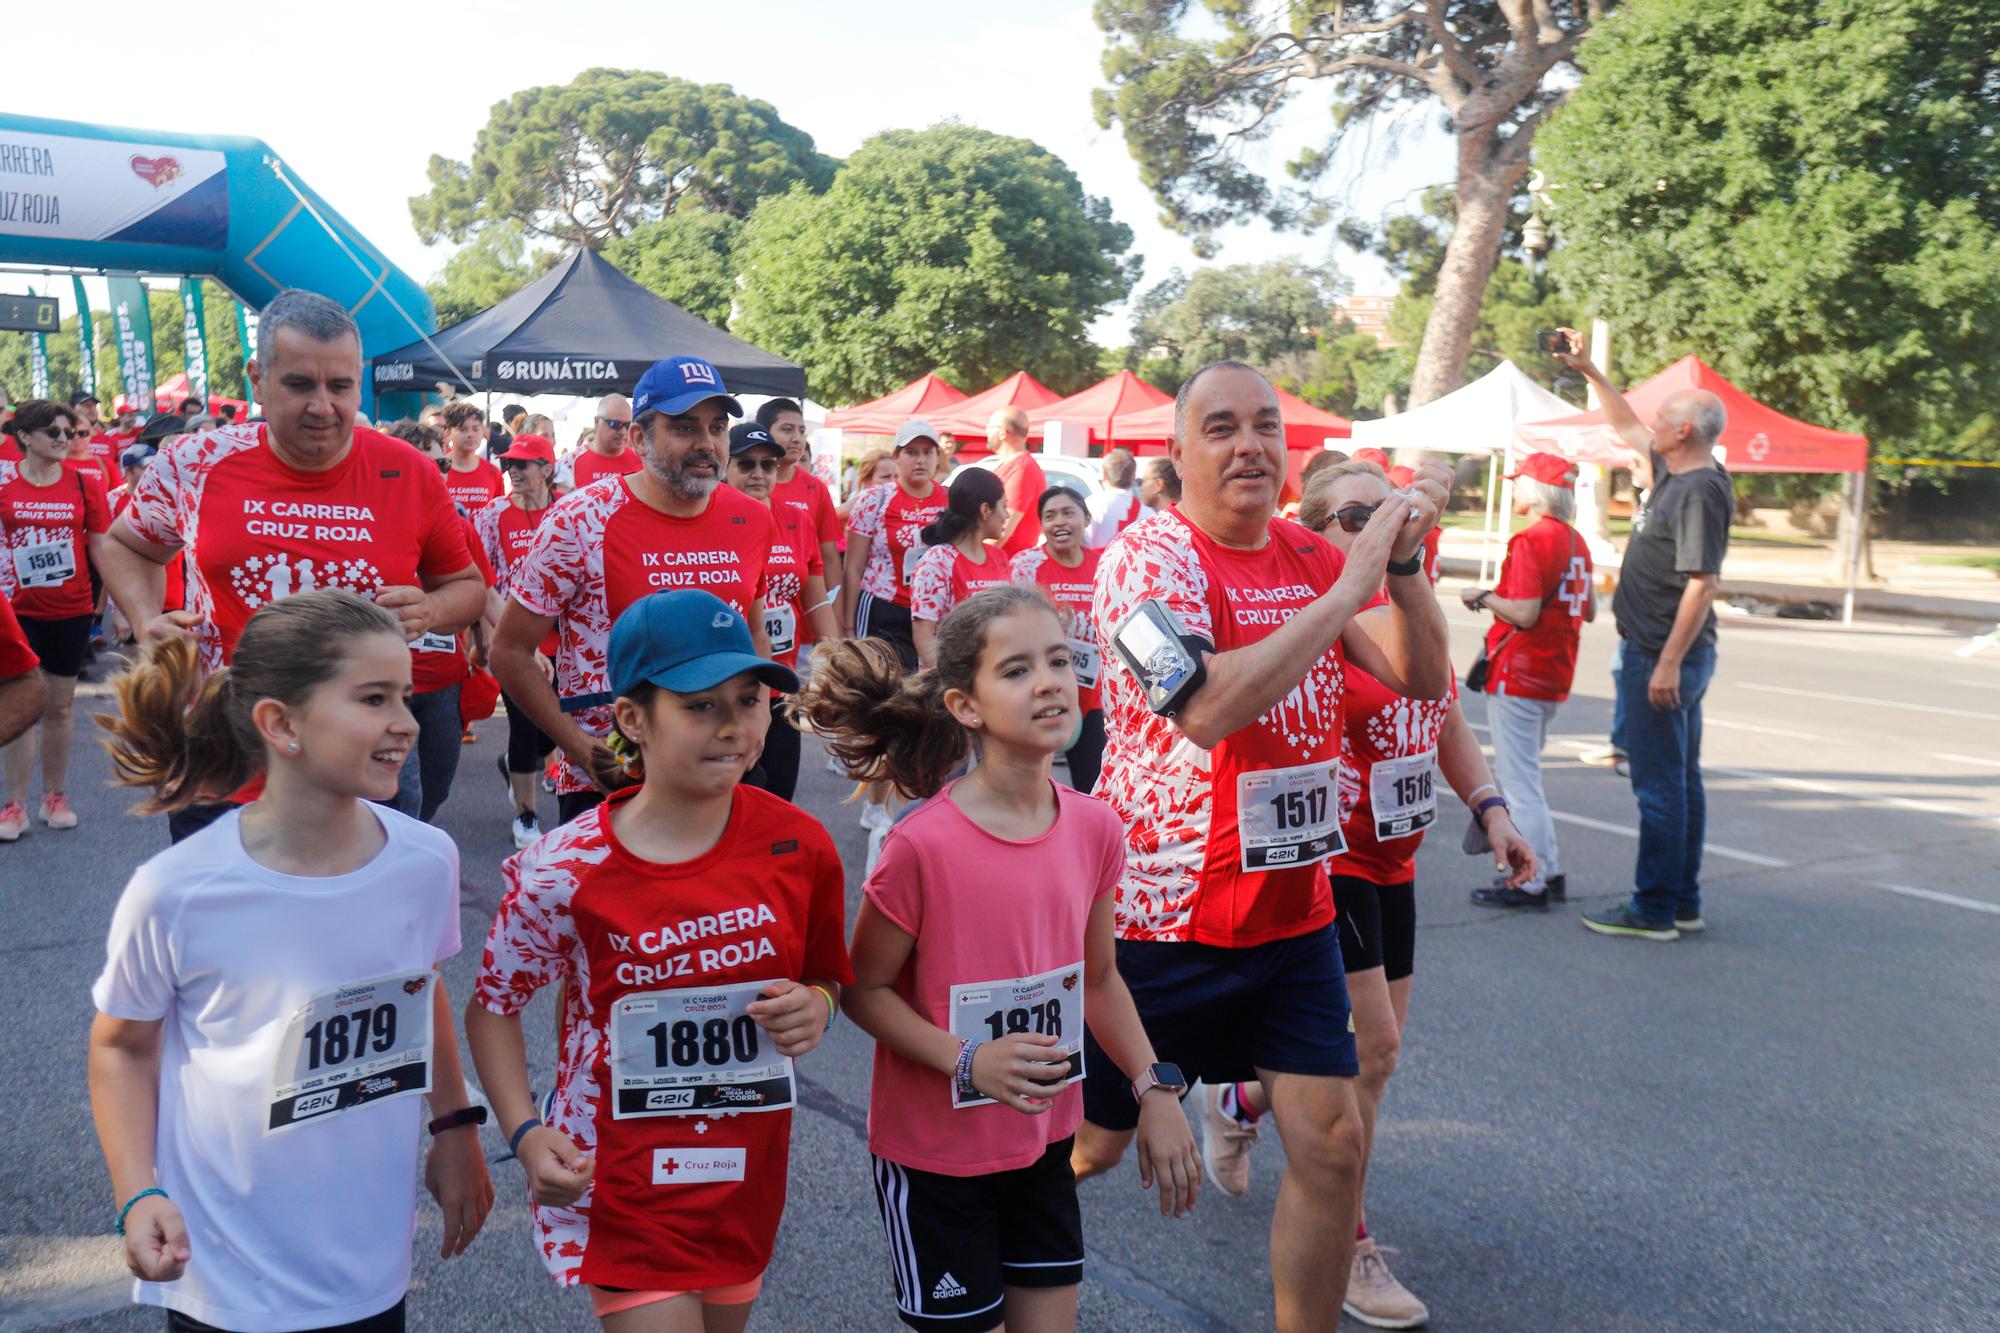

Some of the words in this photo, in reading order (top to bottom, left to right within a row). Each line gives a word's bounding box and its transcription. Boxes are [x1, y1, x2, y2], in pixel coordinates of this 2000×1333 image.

[0, 144, 54, 176] RRERA
[0, 190, 18, 222] UZ
[22, 192, 60, 224] ROJA
[515, 356, 619, 380] RUNÁTICA
[15, 510, 44, 520] CRUZ
[46, 511, 74, 520] ROJA
[25, 501, 75, 511] CARRERA
[243, 499, 266, 515] IX
[270, 501, 375, 522] CARRERA
[245, 519, 309, 540] CRUZ
[314, 525, 374, 543] ROJA
[641, 552, 661, 567] IX
[663, 550, 741, 566] CARRERA
[771, 545, 794, 554] ERA
[28, 551, 64, 570] 1581
[648, 571, 696, 586] CRUZ
[699, 569, 742, 585] ROJA
[1224, 585, 1242, 602] IX
[1242, 583, 1319, 603] CARRERA
[1235, 608, 1281, 626] CRUZ
[765, 619, 783, 637] 43
[1392, 770, 1432, 807] 1518
[1271, 786, 1327, 829] 1517
[1268, 849, 1296, 860] 42K
[607, 932, 636, 955] IX
[638, 903, 777, 954] CARRERA
[615, 953, 694, 986] CRUZ
[700, 937, 777, 973] ROJA
[1020, 982, 1045, 993] CARRERA
[691, 995, 728, 1004] CARRERA
[1014, 994, 1032, 1002] CRUZ
[684, 1005, 706, 1013] CRUZ
[706, 1003, 727, 1012] ROJA
[984, 998, 1062, 1042] 1878
[305, 1003, 397, 1071] 1879
[647, 1014, 759, 1068] 1880
[297, 1093, 335, 1112] 42K
[650, 1093, 690, 1105] 42K
[684, 1160, 710, 1170] Cruz
[713, 1160, 737, 1170] Roja
[932, 1286, 968, 1300] adidas
